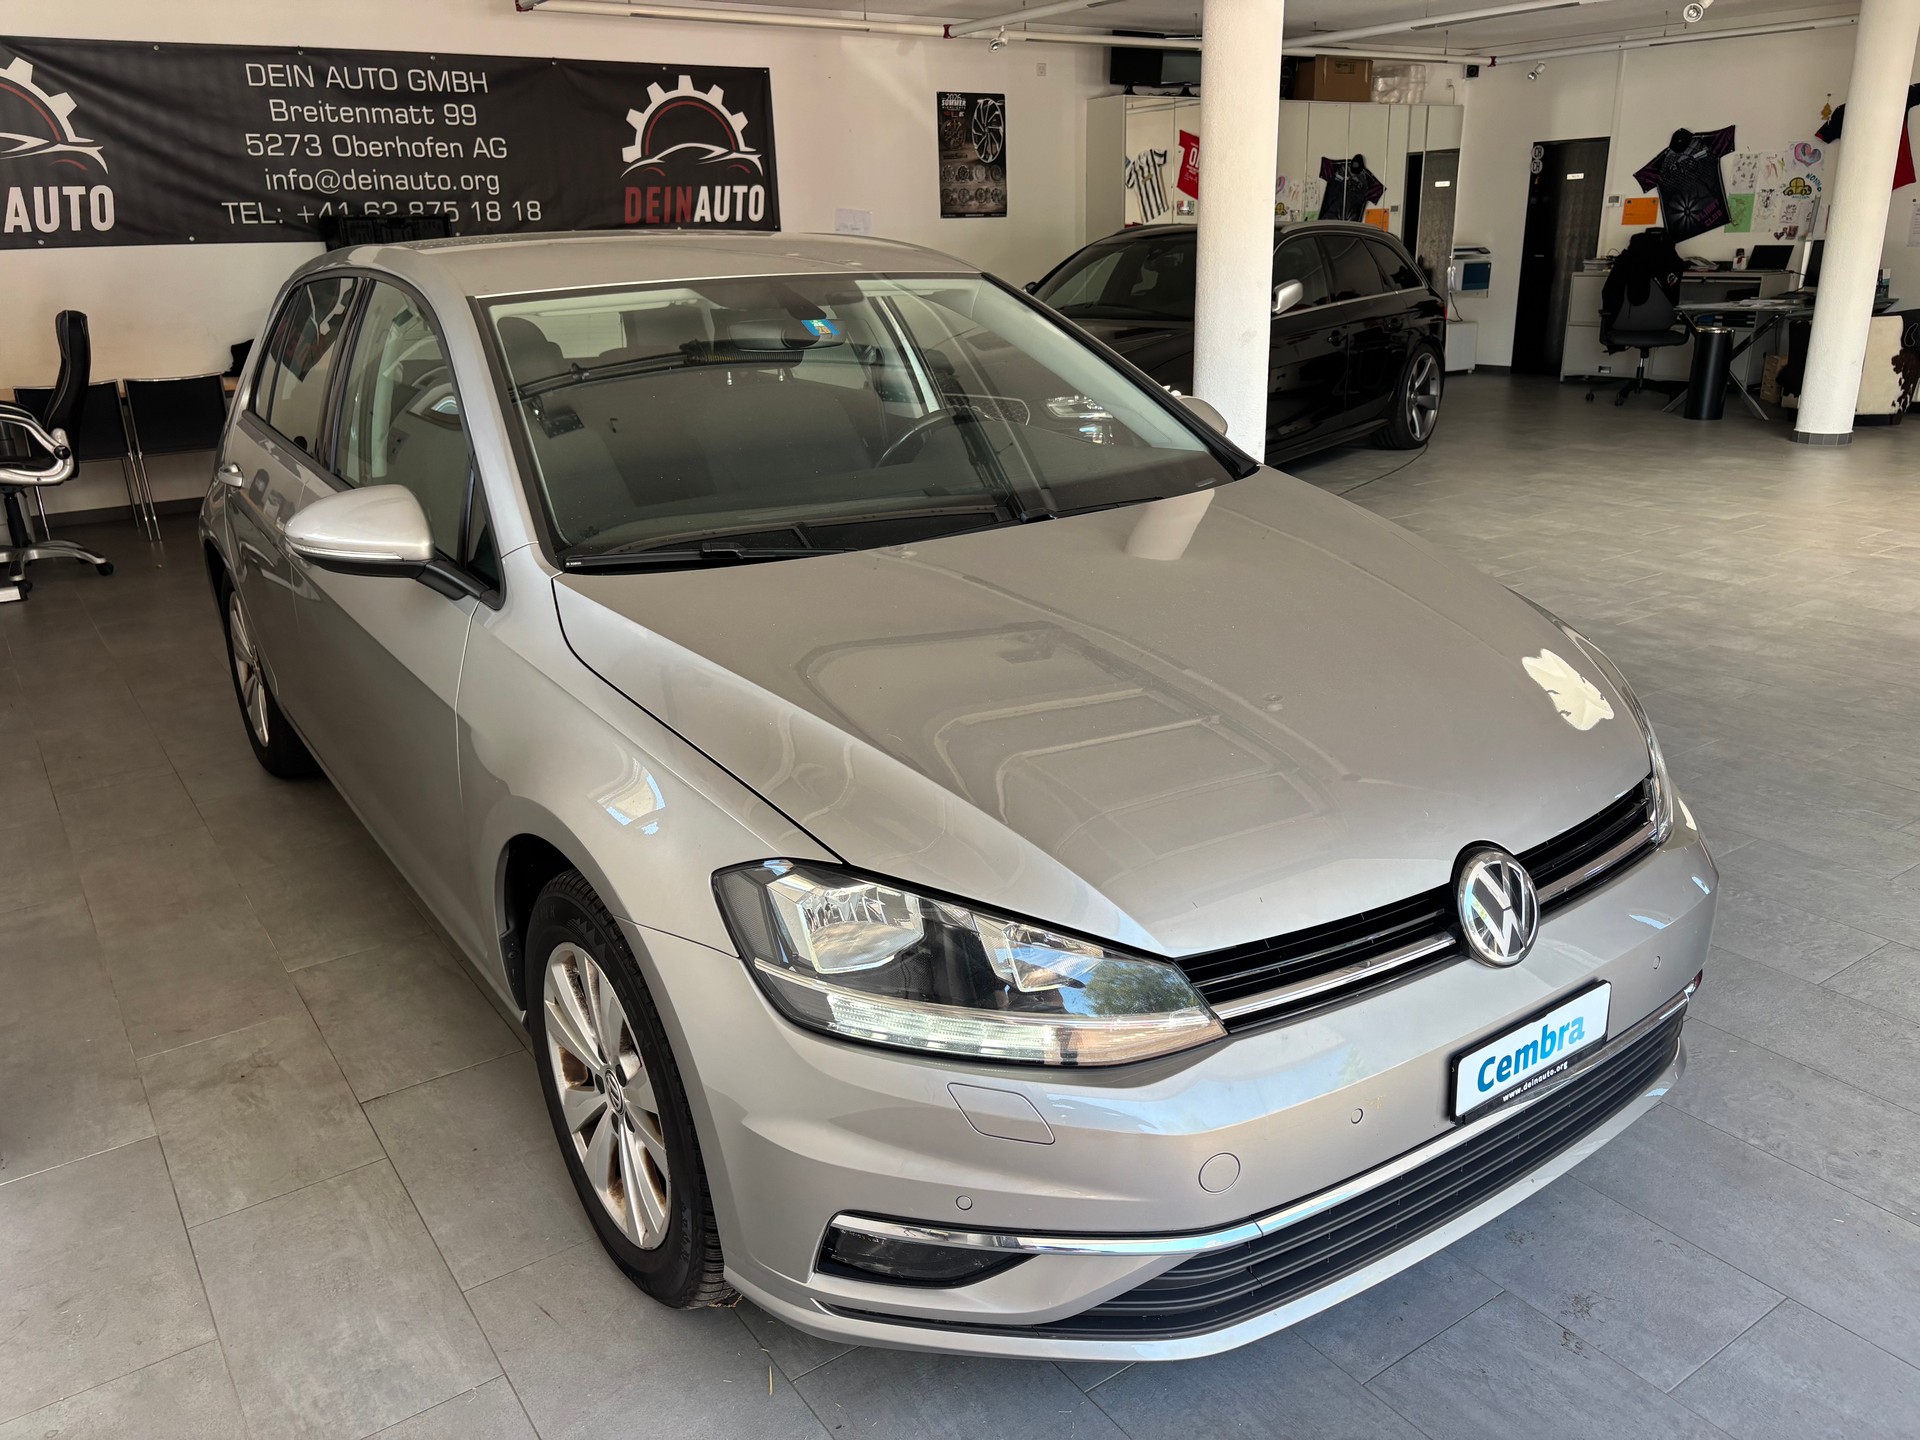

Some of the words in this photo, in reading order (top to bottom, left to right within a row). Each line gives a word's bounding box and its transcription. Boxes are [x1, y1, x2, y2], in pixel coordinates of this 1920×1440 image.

[245, 63, 315, 88] DEIN
[325, 66, 398, 92] AUTO
[407, 69, 489, 94] GMBH
[269, 99, 435, 126] Breitenmatt
[443, 103, 478, 126] 99
[245, 133, 322, 157] 5273
[331, 134, 464, 159] Oberhofen
[472, 136, 508, 159] AG
[265, 168, 500, 196] info@deinauto.org
[3, 185, 115, 233] AUTO
[221, 202, 284, 225] TEL:
[470, 200, 501, 222] 18
[512, 200, 542, 221] 18
[624, 184, 765, 224] DEINAUTO
[1477, 1015, 1585, 1093] Cembra
[1502, 1060, 1569, 1102] www.deinauto.org
